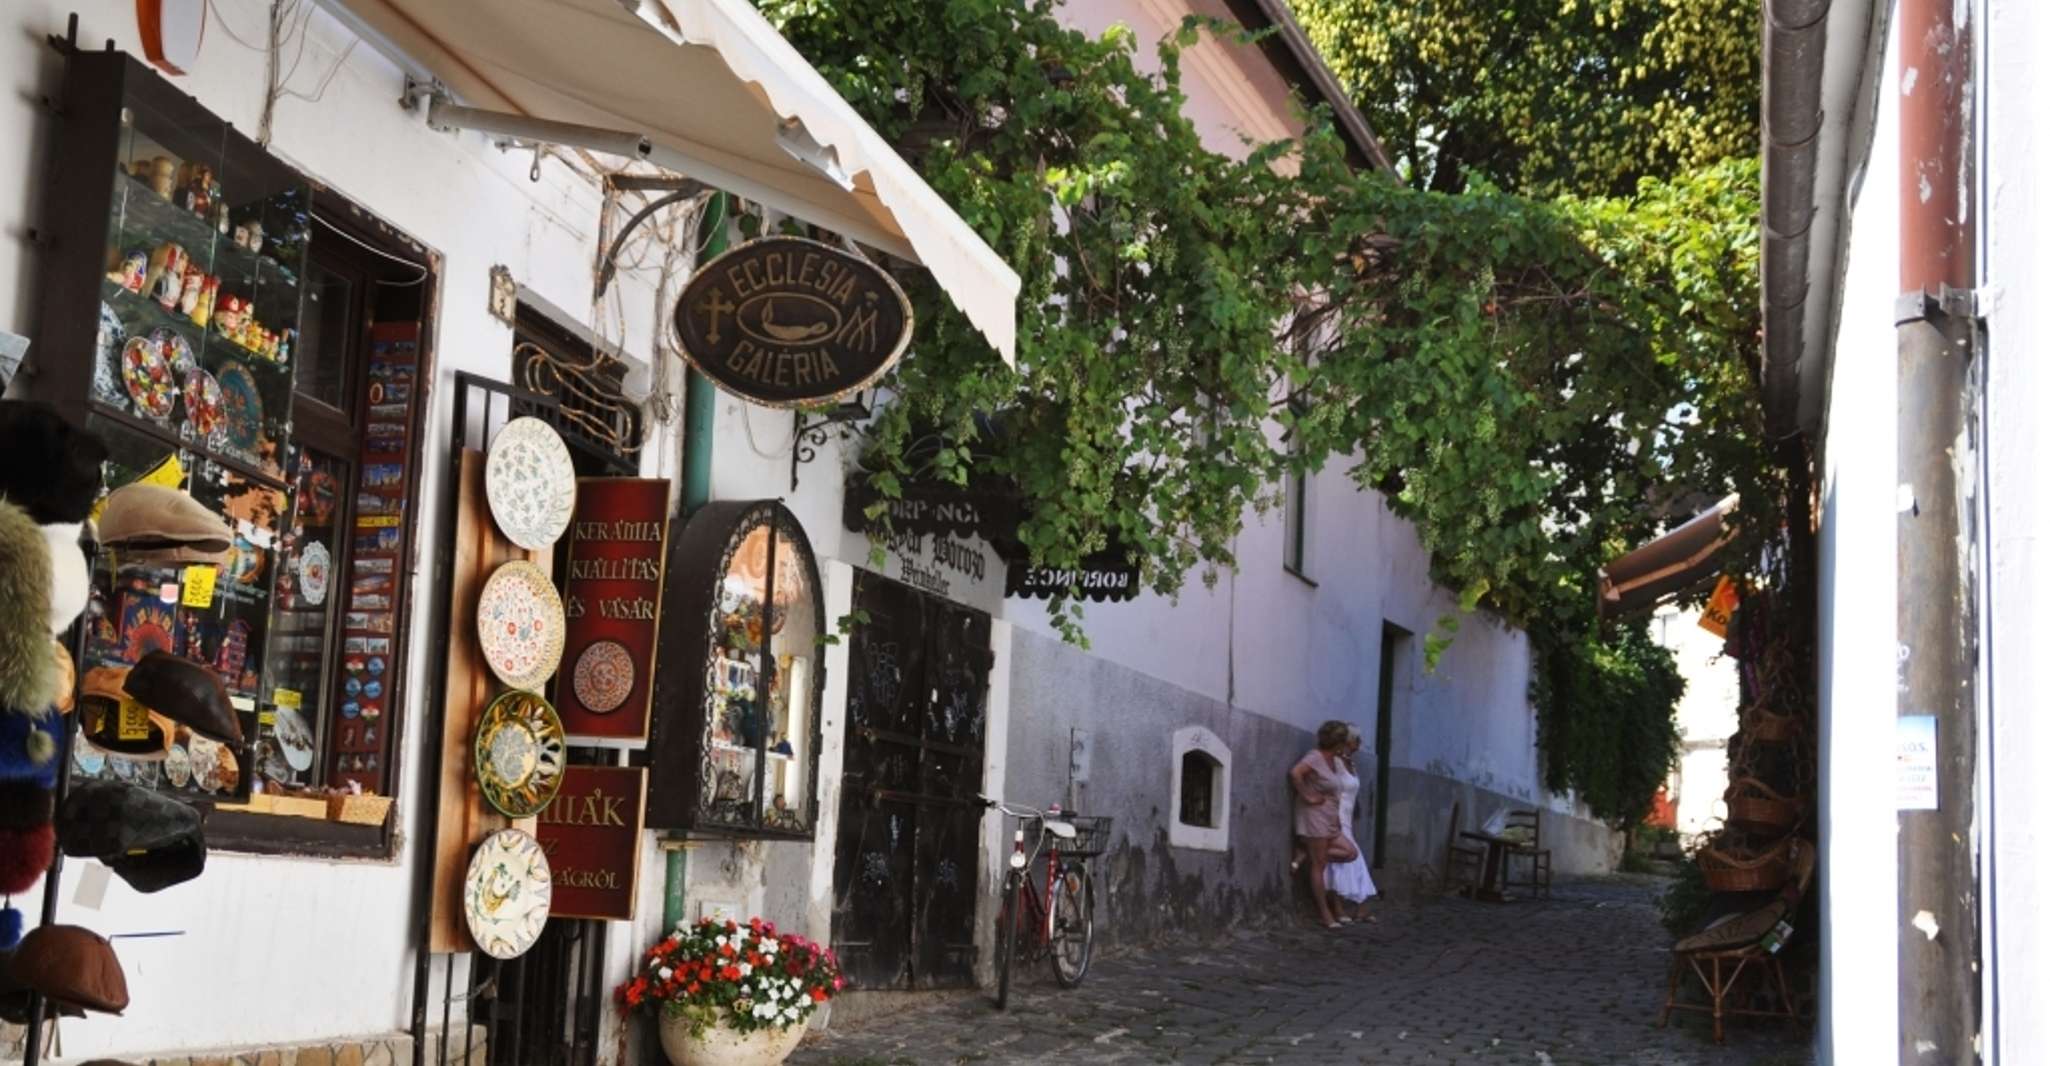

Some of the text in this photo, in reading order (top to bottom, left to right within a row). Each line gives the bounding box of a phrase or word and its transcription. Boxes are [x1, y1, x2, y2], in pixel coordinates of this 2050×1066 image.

[727, 252, 857, 305] ECCLESIA
[725, 339, 840, 387] GALÉRIA
[575, 519, 661, 542] KERÁMIA
[566, 595, 654, 620] ÉS VÁSÁR
